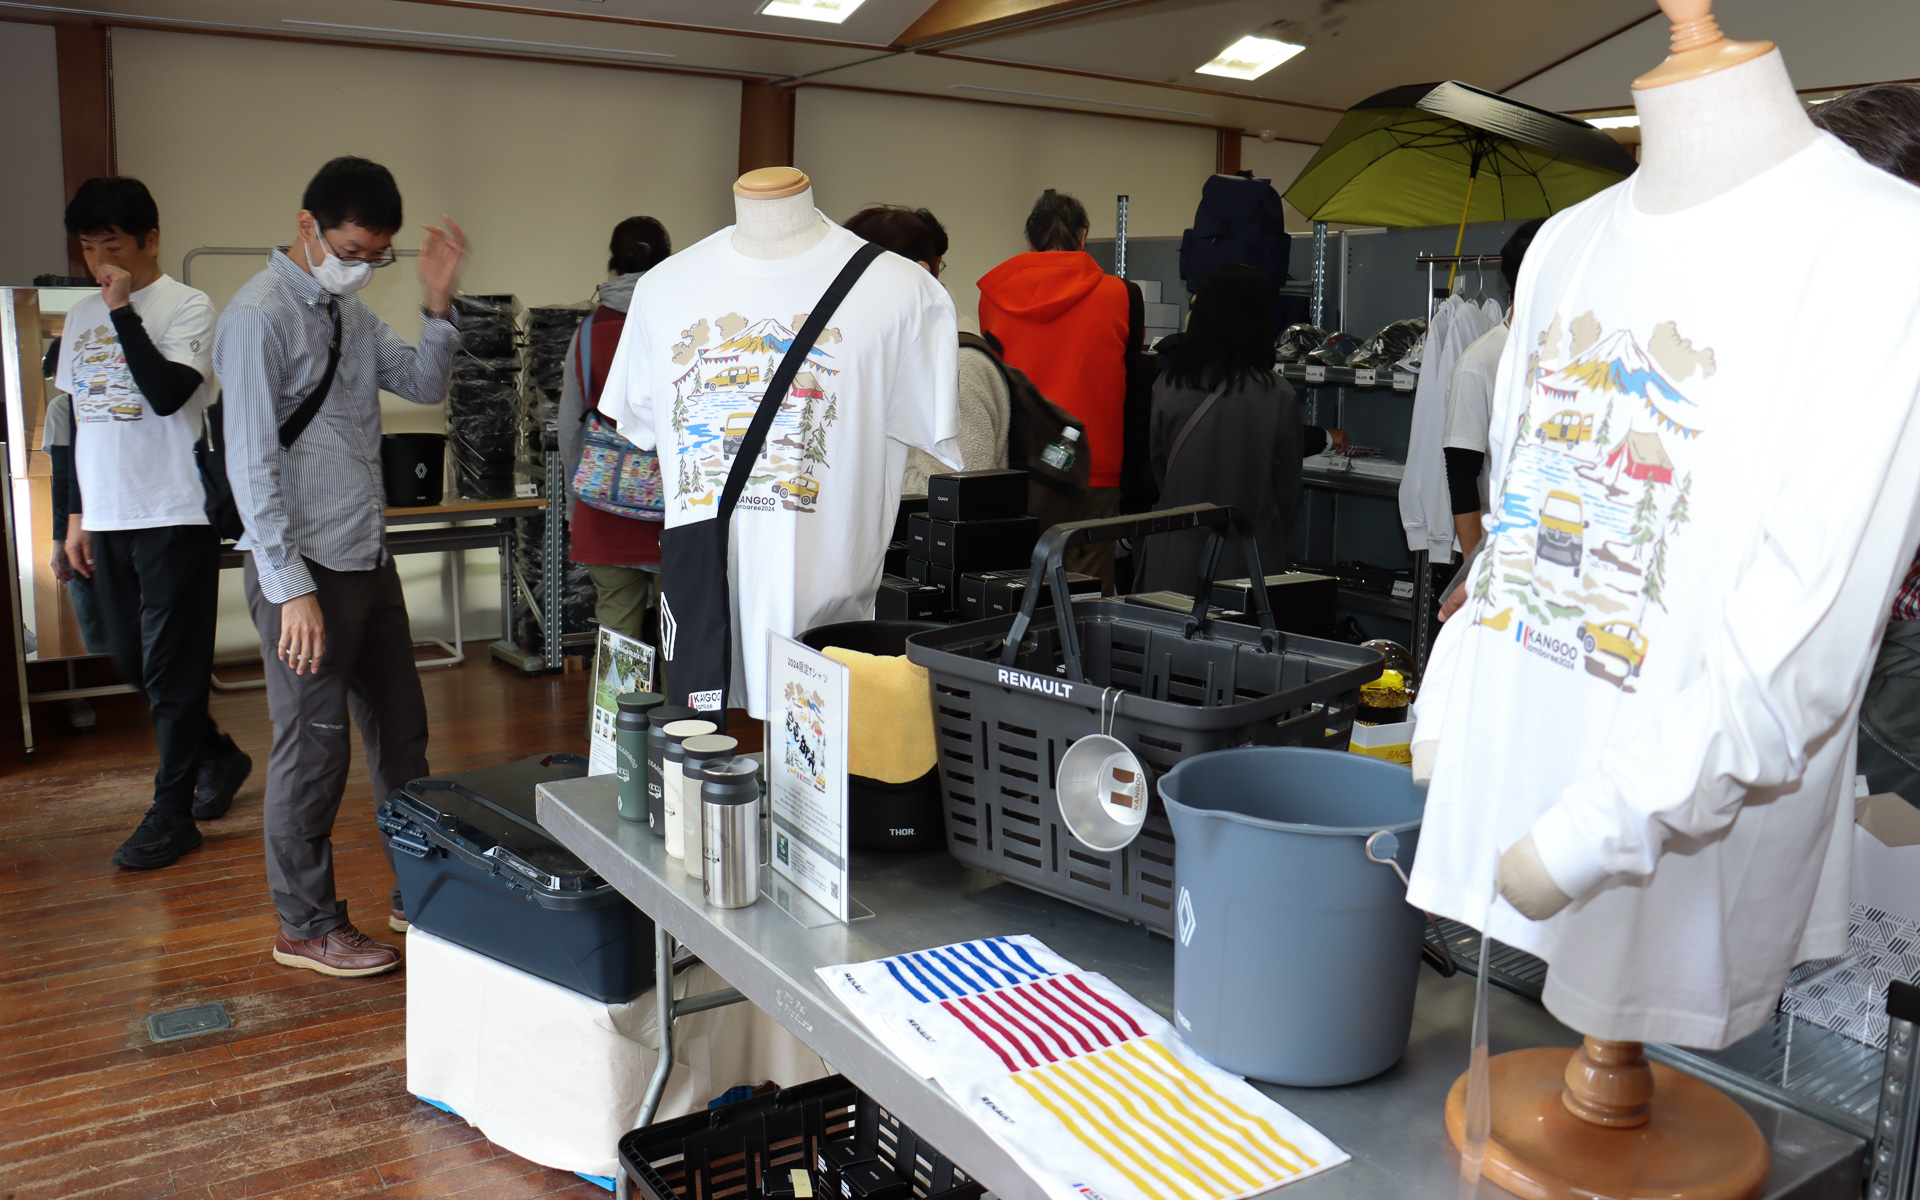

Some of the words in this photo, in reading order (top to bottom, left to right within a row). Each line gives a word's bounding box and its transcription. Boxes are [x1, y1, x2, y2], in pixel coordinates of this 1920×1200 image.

[738, 496, 776, 506] ANGOO
[1528, 628, 1578, 660] KANGOO
[998, 668, 1073, 699] RENAULT
[1134, 772, 1142, 810] KANGOO
[907, 1018, 937, 1043] RENAULT
